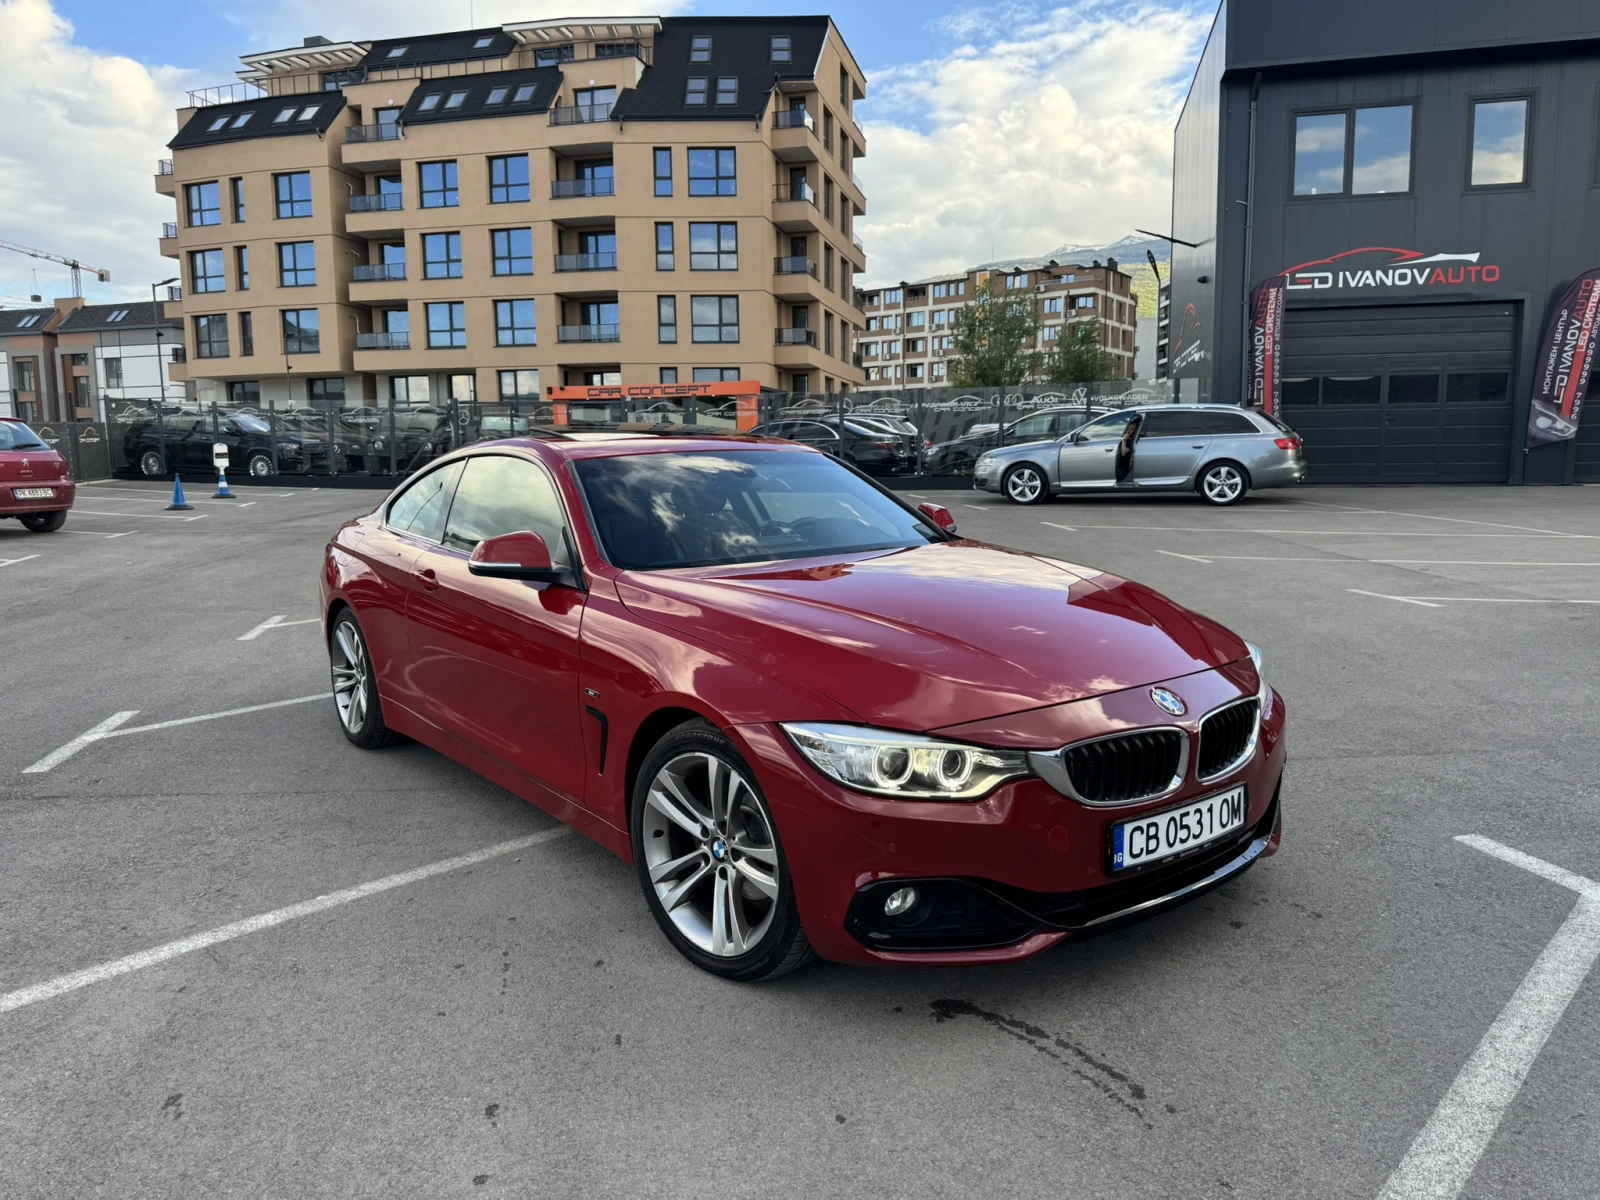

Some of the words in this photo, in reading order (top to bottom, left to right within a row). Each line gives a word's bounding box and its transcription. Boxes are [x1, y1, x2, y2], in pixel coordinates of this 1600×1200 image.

[1286, 272, 1332, 289] LED
[1265, 335, 1273, 354] LED
[1577, 330, 1590, 352] LED
[1542, 346, 1559, 394] МОНТАЖЕН
[1553, 309, 1568, 344] ЦЕНТЪР
[587, 388, 621, 397] CAR
[628, 385, 711, 396] CONCEPT
[1031, 395, 1058, 404] Audi
[1129, 822, 1160, 859] CB
[1165, 803, 1213, 848] 0531
[1220, 791, 1241, 829] OM
